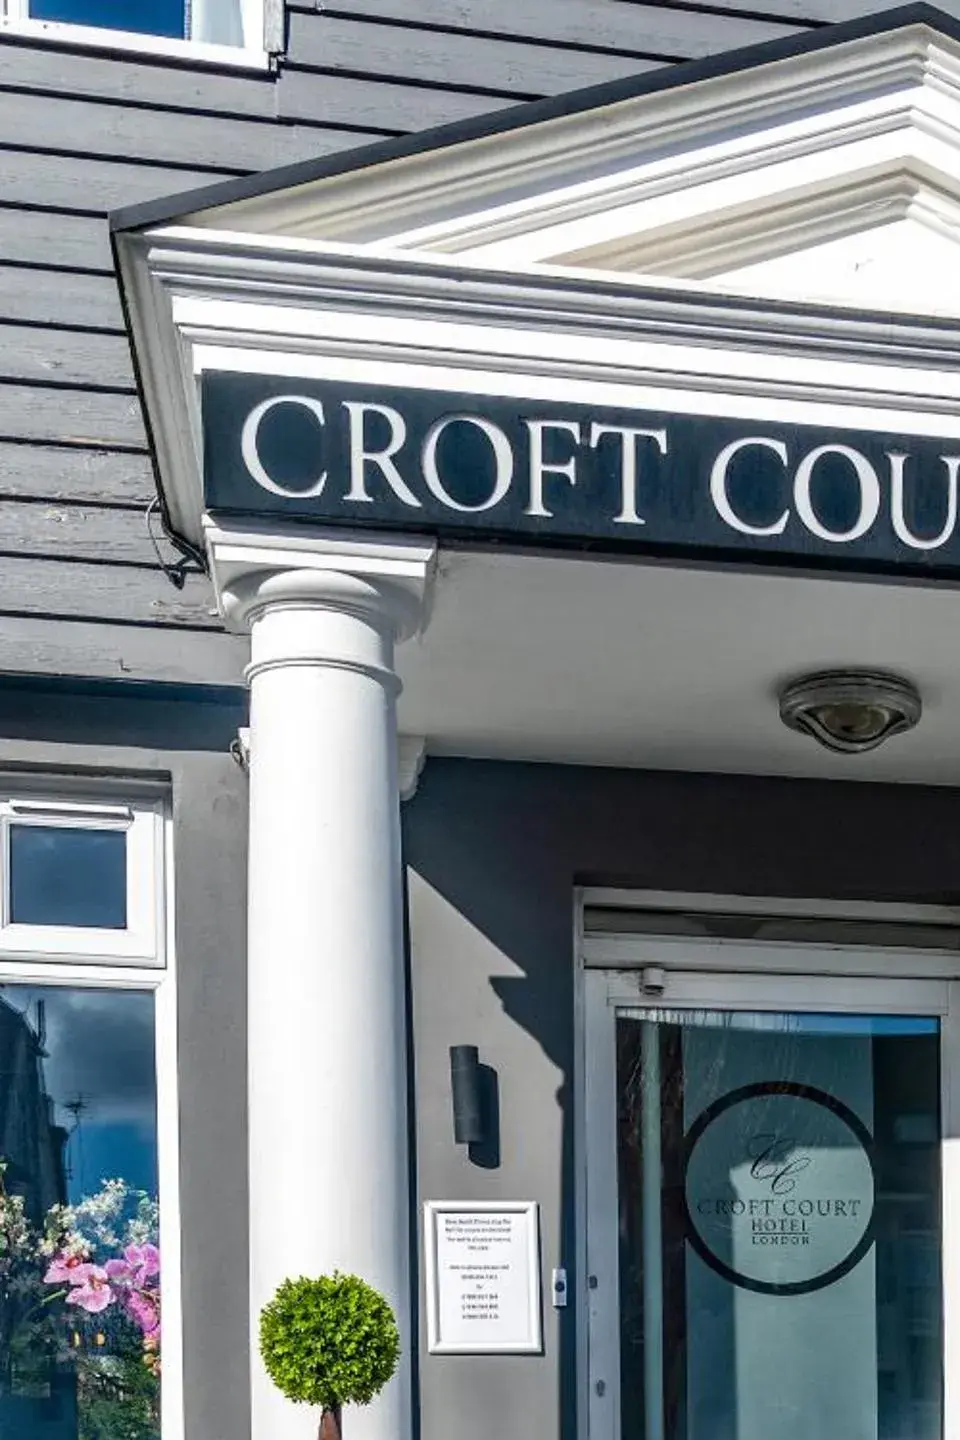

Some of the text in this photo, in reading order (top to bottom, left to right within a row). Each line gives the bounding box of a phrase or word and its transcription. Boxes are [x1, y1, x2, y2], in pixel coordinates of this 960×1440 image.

[240, 395, 668, 525] CROFT
[697, 1199, 862, 1217] CROFT COURT
[751, 1218, 809, 1232] HOTEL
[751, 1235, 810, 1246] LONDON
